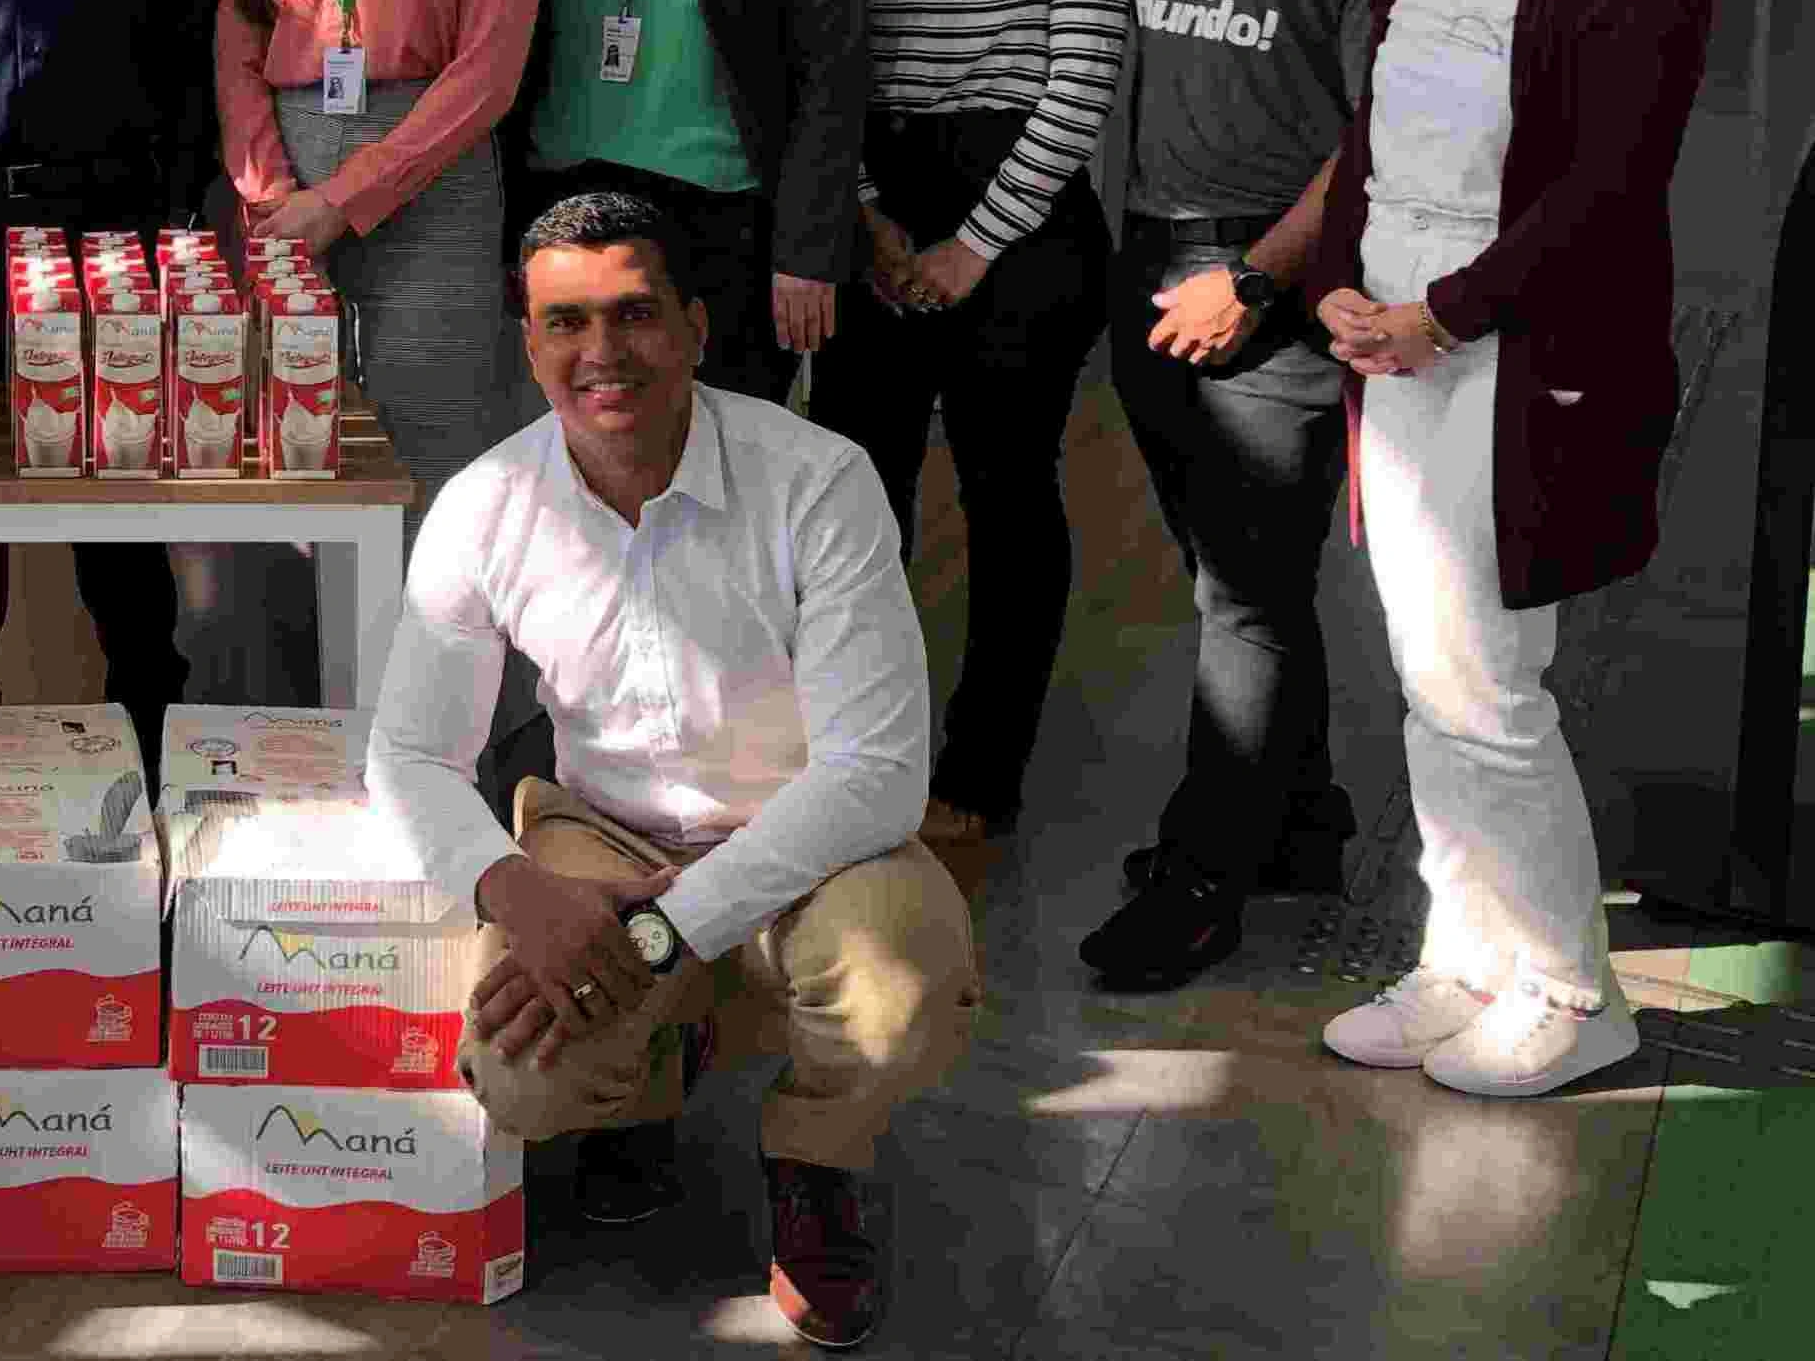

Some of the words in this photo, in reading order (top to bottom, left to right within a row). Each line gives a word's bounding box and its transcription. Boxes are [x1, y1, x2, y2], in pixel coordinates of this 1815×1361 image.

[238, 924, 399, 970] Maná
[237, 1013, 278, 1041] 12
[257, 1105, 417, 1155] Maná
[250, 1222, 290, 1250] 12
